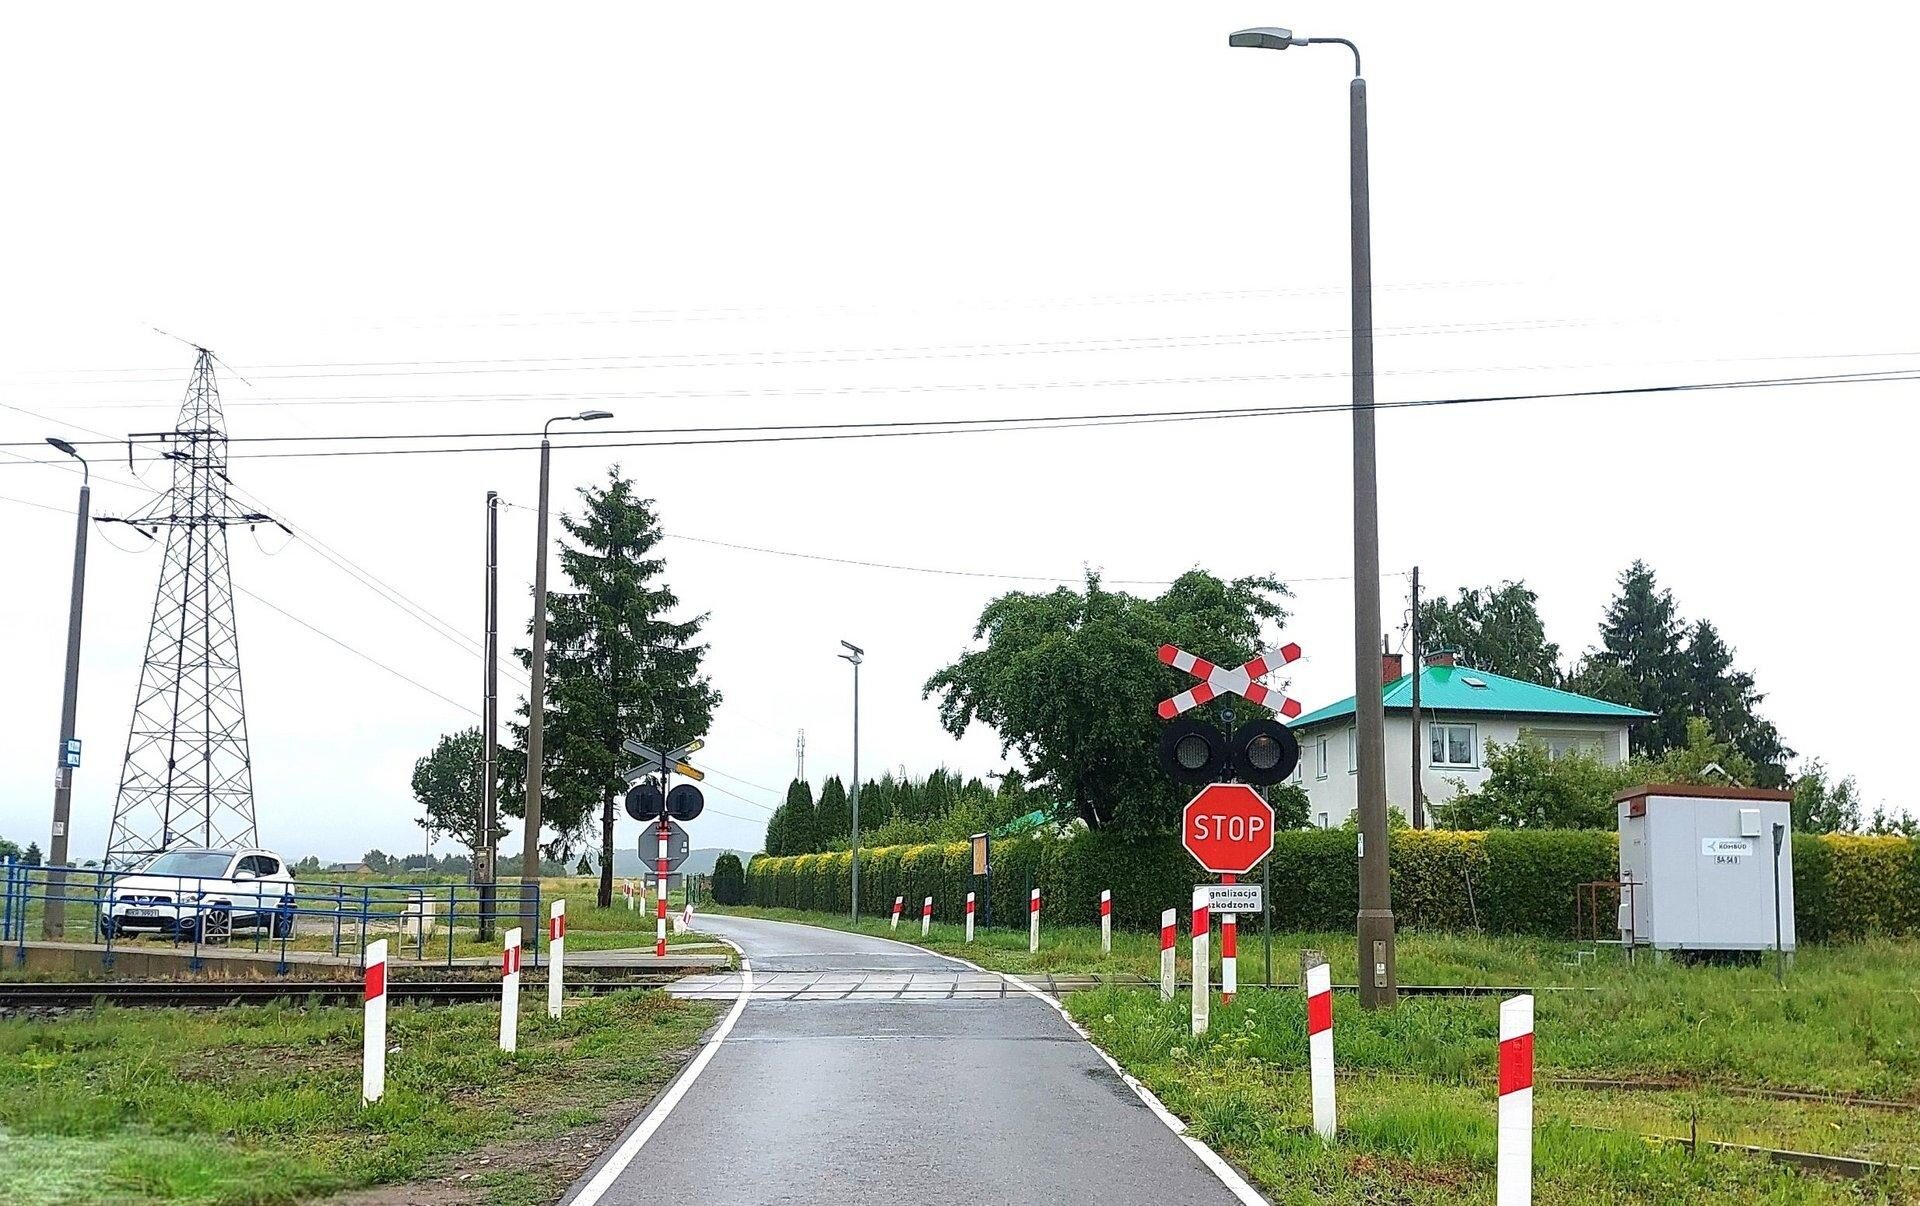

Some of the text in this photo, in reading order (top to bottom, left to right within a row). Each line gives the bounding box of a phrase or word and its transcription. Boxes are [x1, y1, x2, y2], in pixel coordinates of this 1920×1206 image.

[1194, 814, 1264, 842] STOP
[1209, 888, 1258, 899] gnalizacja
[1208, 900, 1255, 909] szkodzona
